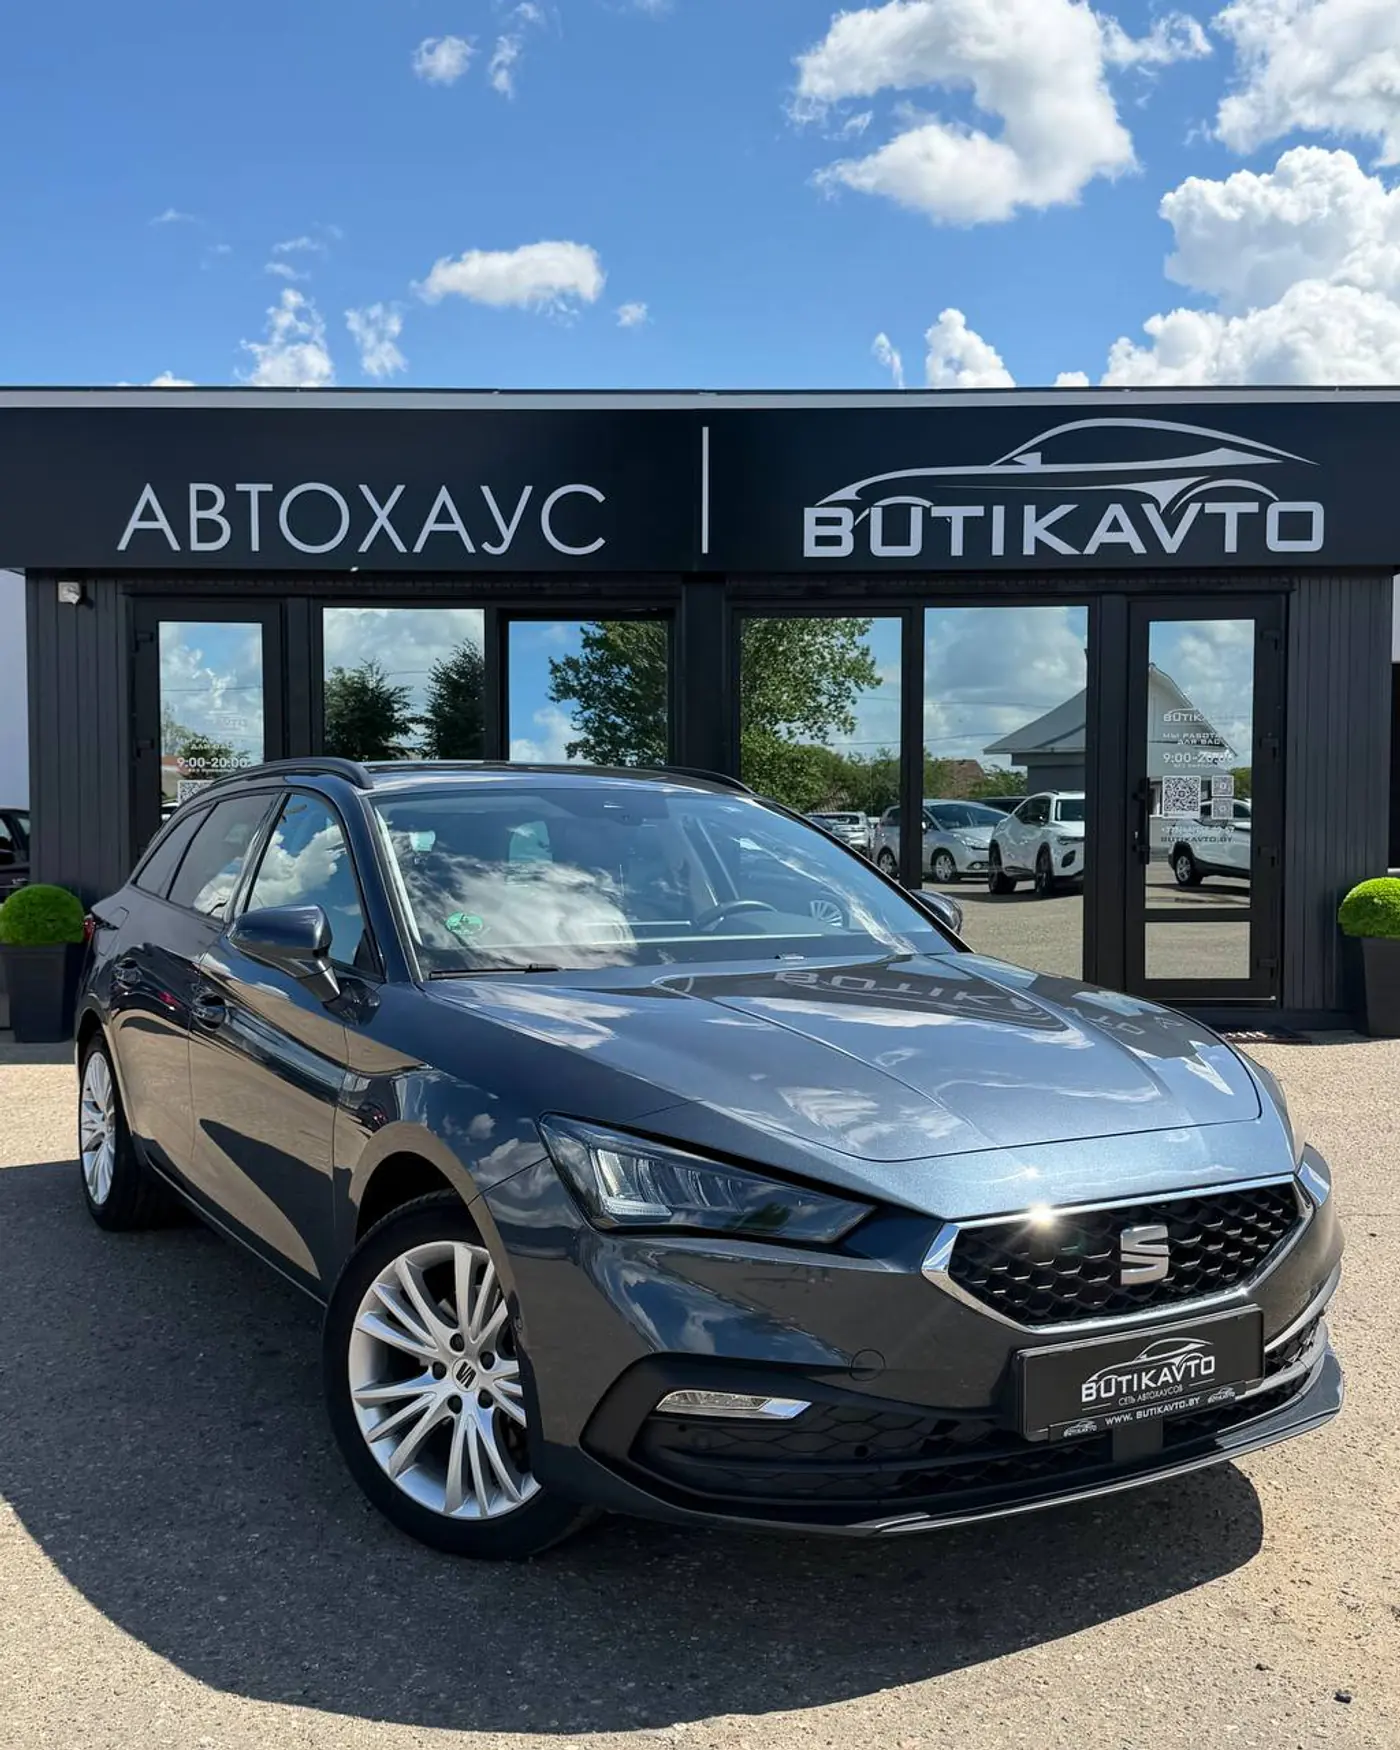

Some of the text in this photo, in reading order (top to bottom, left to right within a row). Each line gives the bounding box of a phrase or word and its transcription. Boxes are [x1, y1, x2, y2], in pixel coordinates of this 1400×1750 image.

[117, 482, 606, 555] АВТОХАУС
[803, 501, 1324, 558] BUTIKAVTO
[177, 757, 247, 768] 9:00-20:00
[1081, 1355, 1215, 1402] BUTIKAVTO
[1105, 1413, 1133, 1425] WWW.
